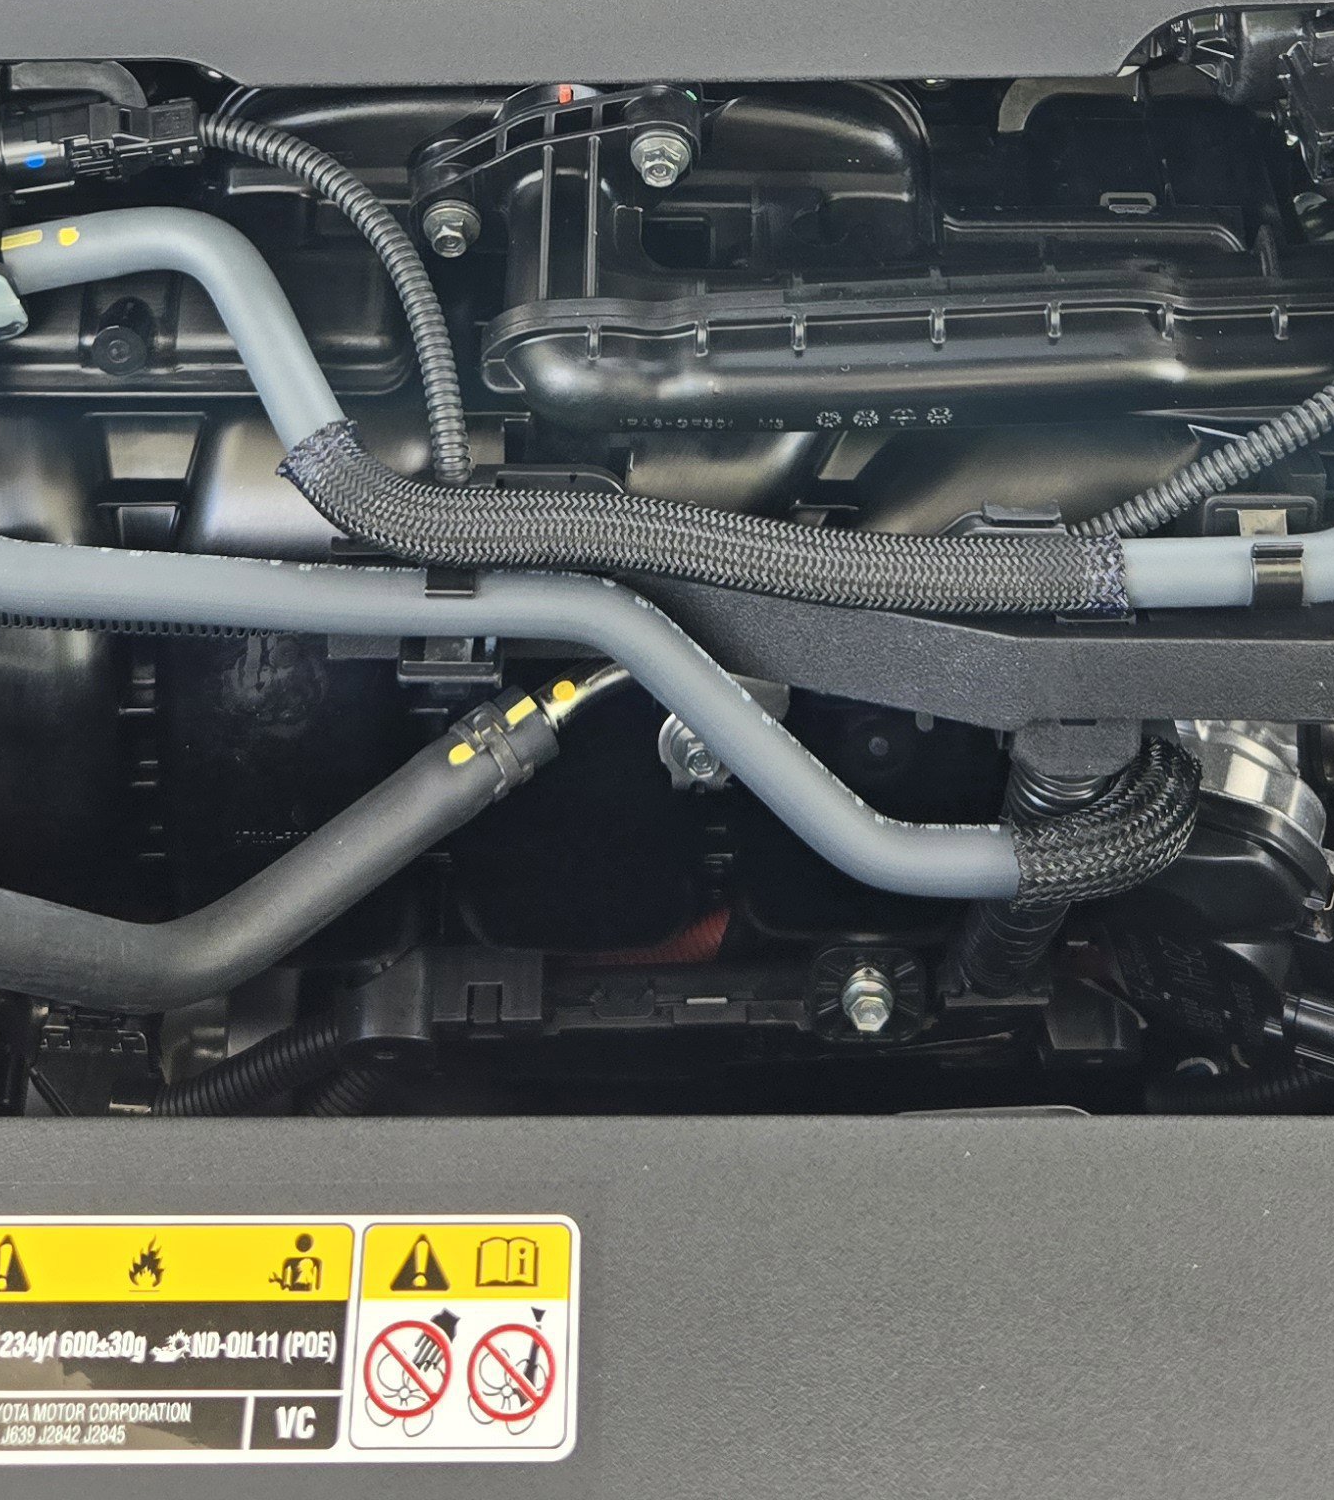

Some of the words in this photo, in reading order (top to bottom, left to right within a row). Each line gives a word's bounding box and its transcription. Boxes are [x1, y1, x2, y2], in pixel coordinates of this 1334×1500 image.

[282, 1330, 338, 1364] (POE)
[31, 1402, 86, 1423] MOTOR
[89, 1402, 193, 1423] CORPORATION
[275, 1403, 317, 1440] VC
[0, 1424, 37, 1445] J639
[37, 1424, 82, 1445] J2842
[82, 1424, 127, 1445] J2845
